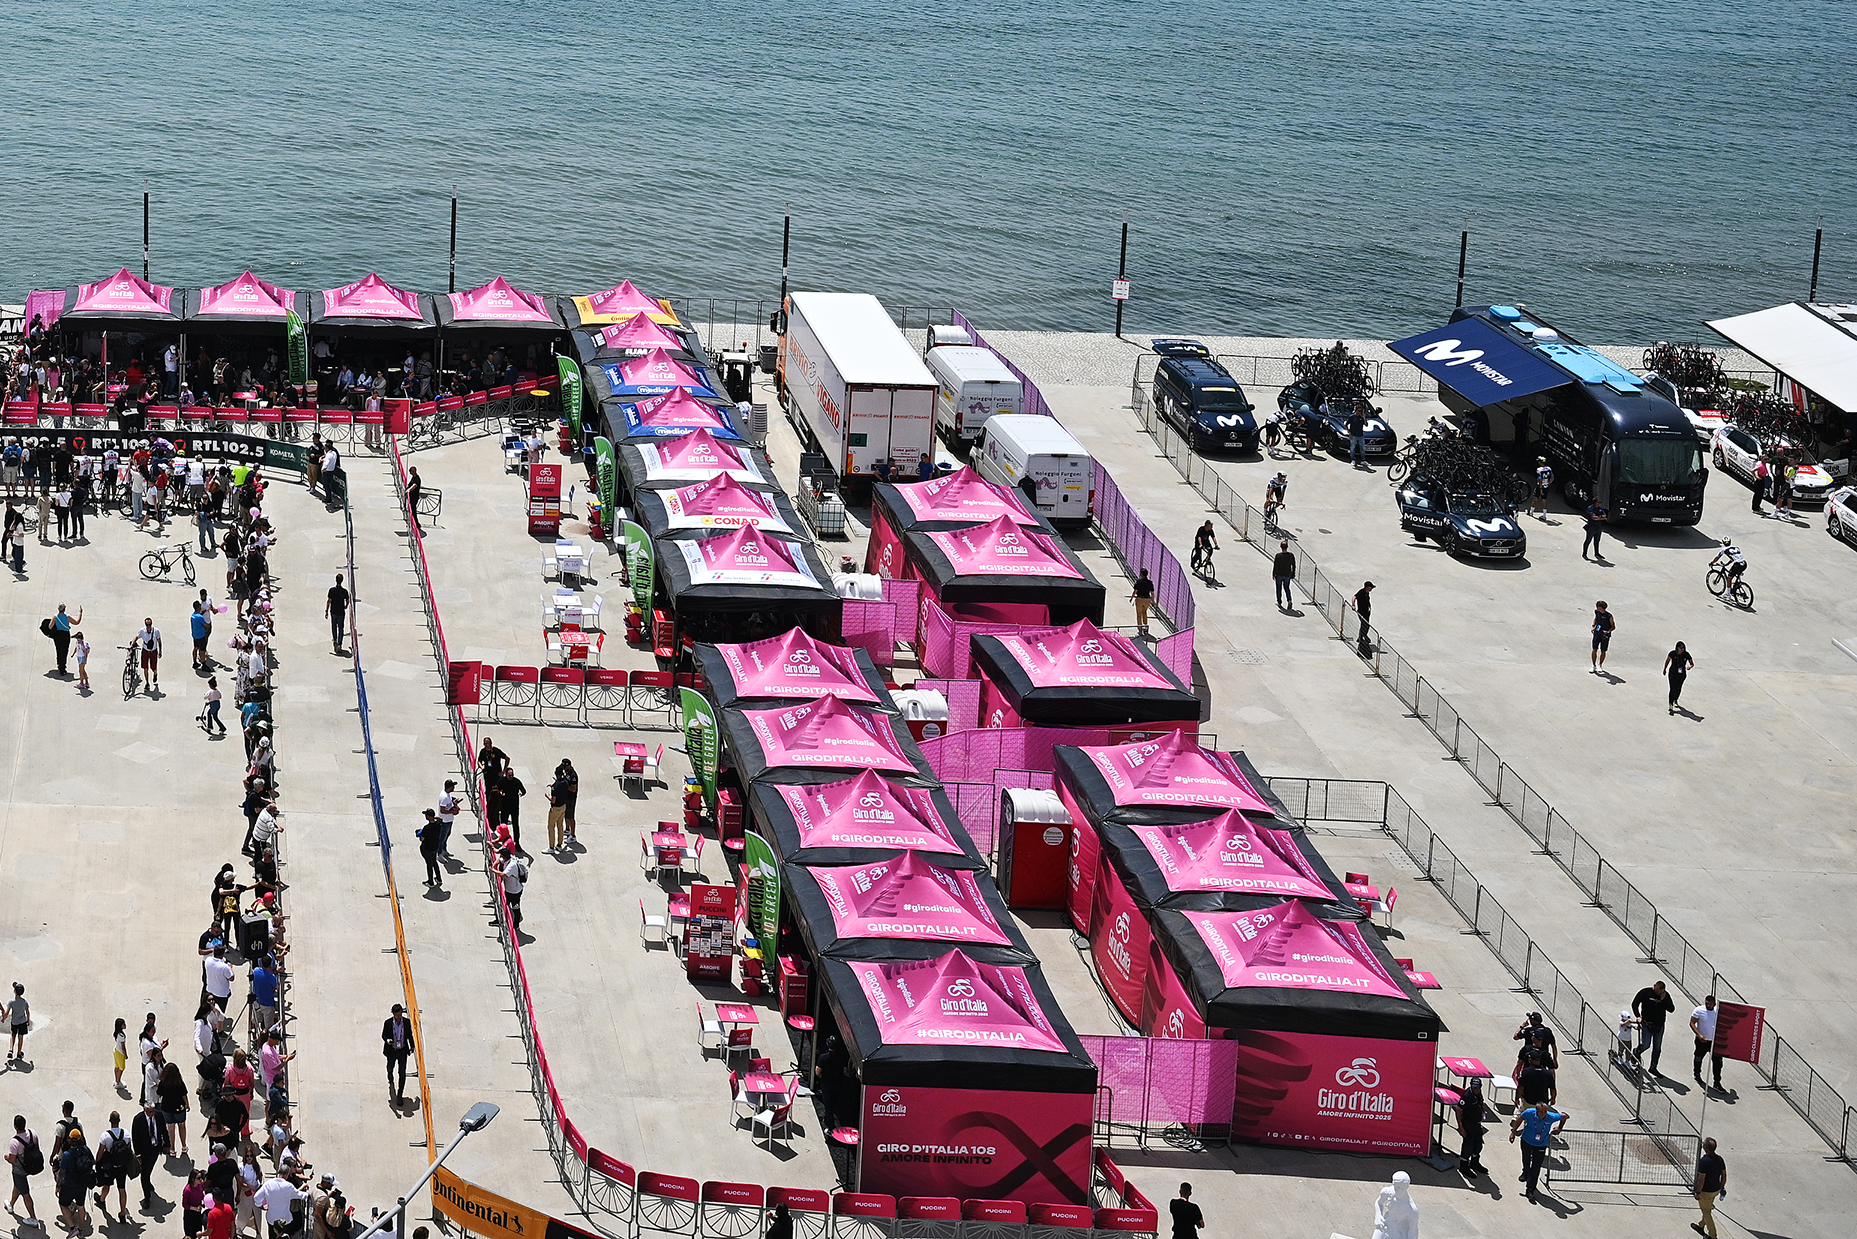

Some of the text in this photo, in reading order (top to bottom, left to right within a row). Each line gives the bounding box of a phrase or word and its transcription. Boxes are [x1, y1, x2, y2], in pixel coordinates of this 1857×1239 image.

[342, 307, 405, 315] GIRODITALIA.IT
[1470, 360, 1514, 387] MOVISTAR
[192, 440, 264, 458] RTL 102.5
[270, 448, 294, 459] KOMETA
[1656, 494, 1685, 502] Movistar
[1008, 546, 1028, 554] d'Italia
[748, 554, 768, 562] d'Italia
[979, 565, 1055, 573] #GIRODITALIA
[1076, 655, 1113, 663] Giro d'Italia
[784, 664, 820, 674] Giro d'Italia
[764, 686, 849, 694] #GIRODITALIA
[824, 738, 875, 746] #giroditalia
[703, 728, 713, 780] RIDE GREEN
[792, 754, 888, 764] GIRODITALIA.IT
[1174, 776, 1227, 786] #giroditalia
[1142, 792, 1242, 803] GIRODITALIA.IT
[853, 808, 894, 820] Giro d'Italia
[831, 834, 927, 845] #GIRODITALIA
[1145, 831, 1180, 874] GIRODITALIA.IT
[1220, 851, 1263, 863] Giro d'Italia
[1200, 878, 1299, 889] #GIRODITALIA
[763, 880, 776, 940] RIDE GREEN
[903, 903, 962, 914] #giroditalia
[867, 923, 977, 935] GIRODITALIA.IT
[1292, 953, 1354, 965] #giroditalia
[1254, 972, 1370, 987] GIRODITALIA.IT
[864, 970, 896, 1024] GIRODITALIA.IT
[941, 998, 987, 1012] Giro d'Italia
[917, 1030, 1026, 1042] #GIRODITALIA
[1318, 1089, 1394, 1112] Giro d'Italia
[872, 1103, 906, 1113] Giro d'Italia
[1319, 1136, 1421, 1148] GIRODITALIA.IT #GIRODITALIA
[877, 1144, 996, 1155] GIRO D'ITALIA 108
[881, 1153, 992, 1164] AMORE INFINITO
[604, 1162, 624, 1175] PUCCINI
[659, 1182, 684, 1191] PUCCINI
[724, 1189, 750, 1197] PUCCINI
[433, 1172, 508, 1230] ontinental
[788, 1195, 815, 1203] PUCCINI
